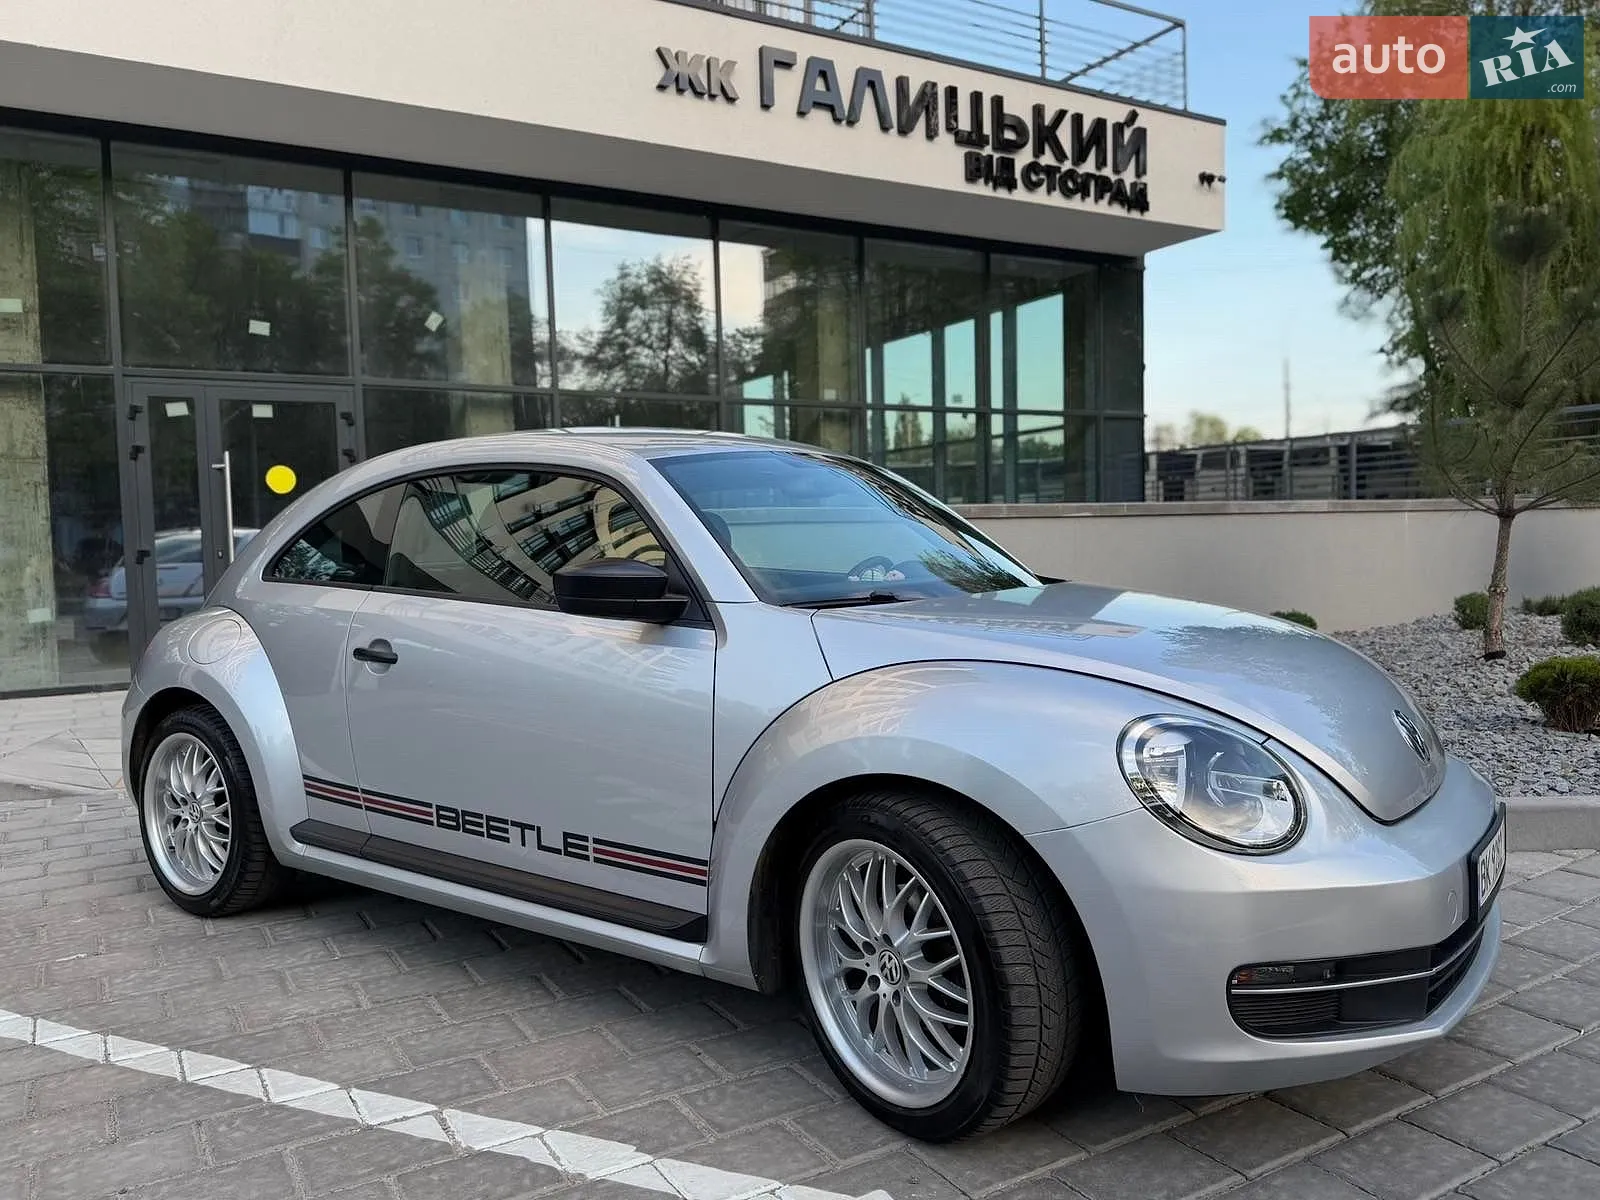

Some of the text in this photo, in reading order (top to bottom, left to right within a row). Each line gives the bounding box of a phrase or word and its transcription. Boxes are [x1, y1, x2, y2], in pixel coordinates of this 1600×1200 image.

[655, 44, 1148, 179] ЖК ГАЛИЦЬКИЙ
[964, 151, 1018, 194] ВІД
[435, 804, 591, 862] BEETLE
